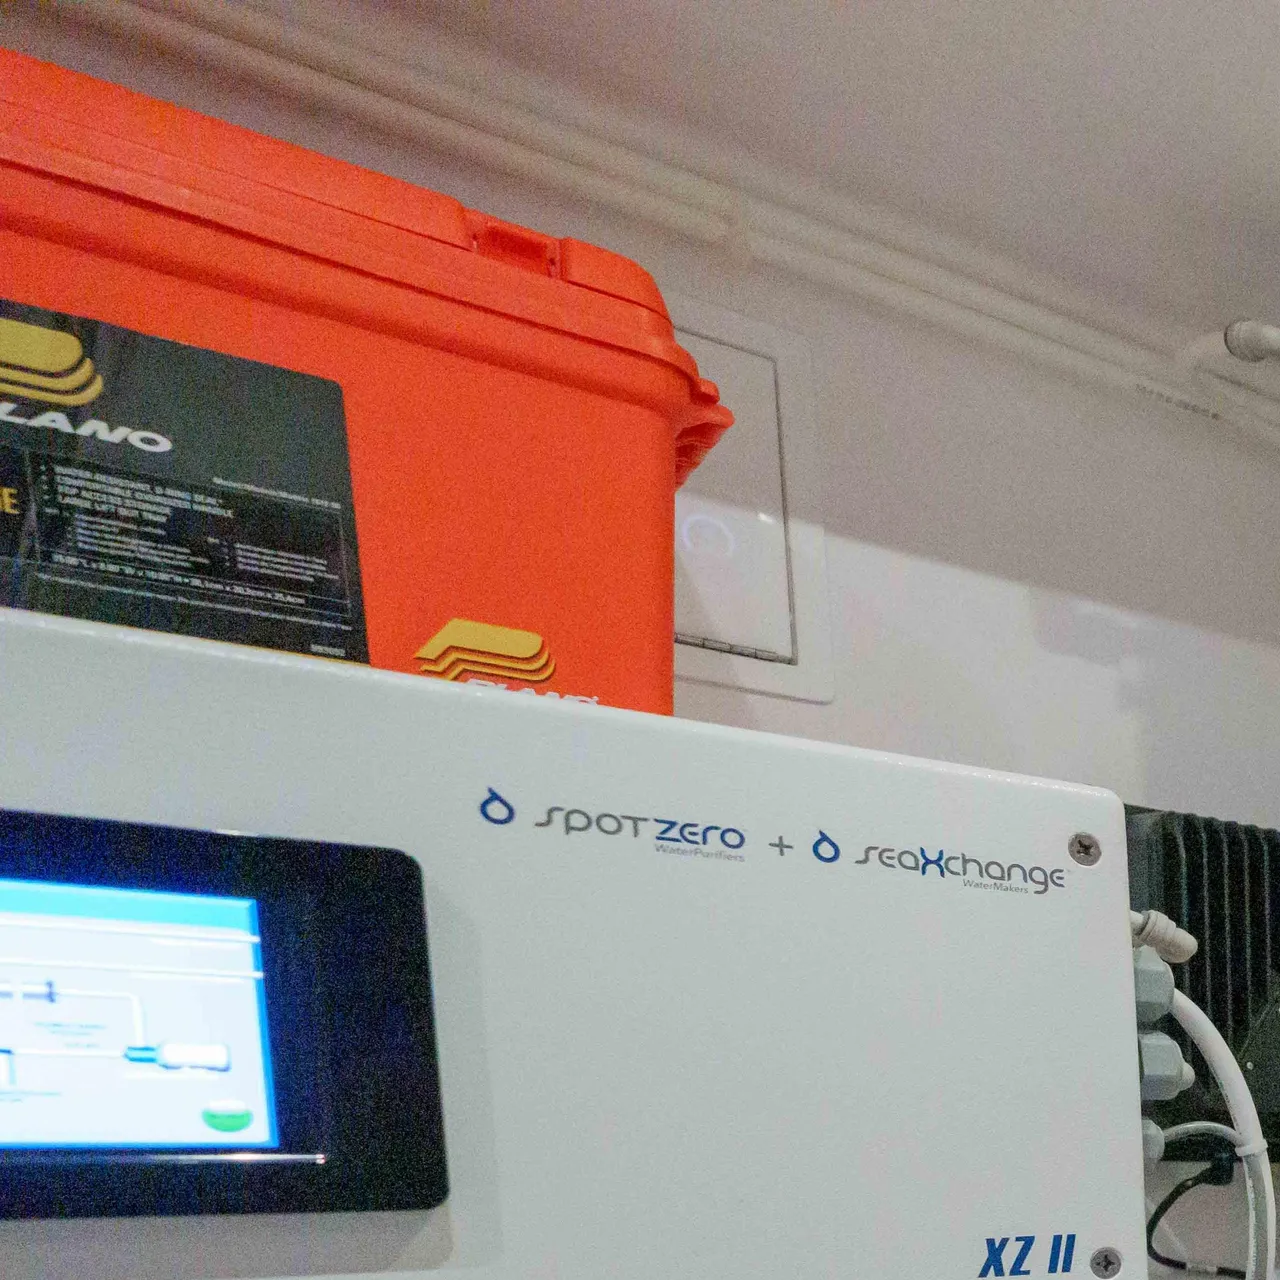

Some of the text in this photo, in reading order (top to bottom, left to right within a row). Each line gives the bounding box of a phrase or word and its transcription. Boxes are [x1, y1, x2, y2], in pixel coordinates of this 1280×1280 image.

[962, 879, 1029, 895] WaterMakers
[977, 1233, 1077, 1279] XZ II
